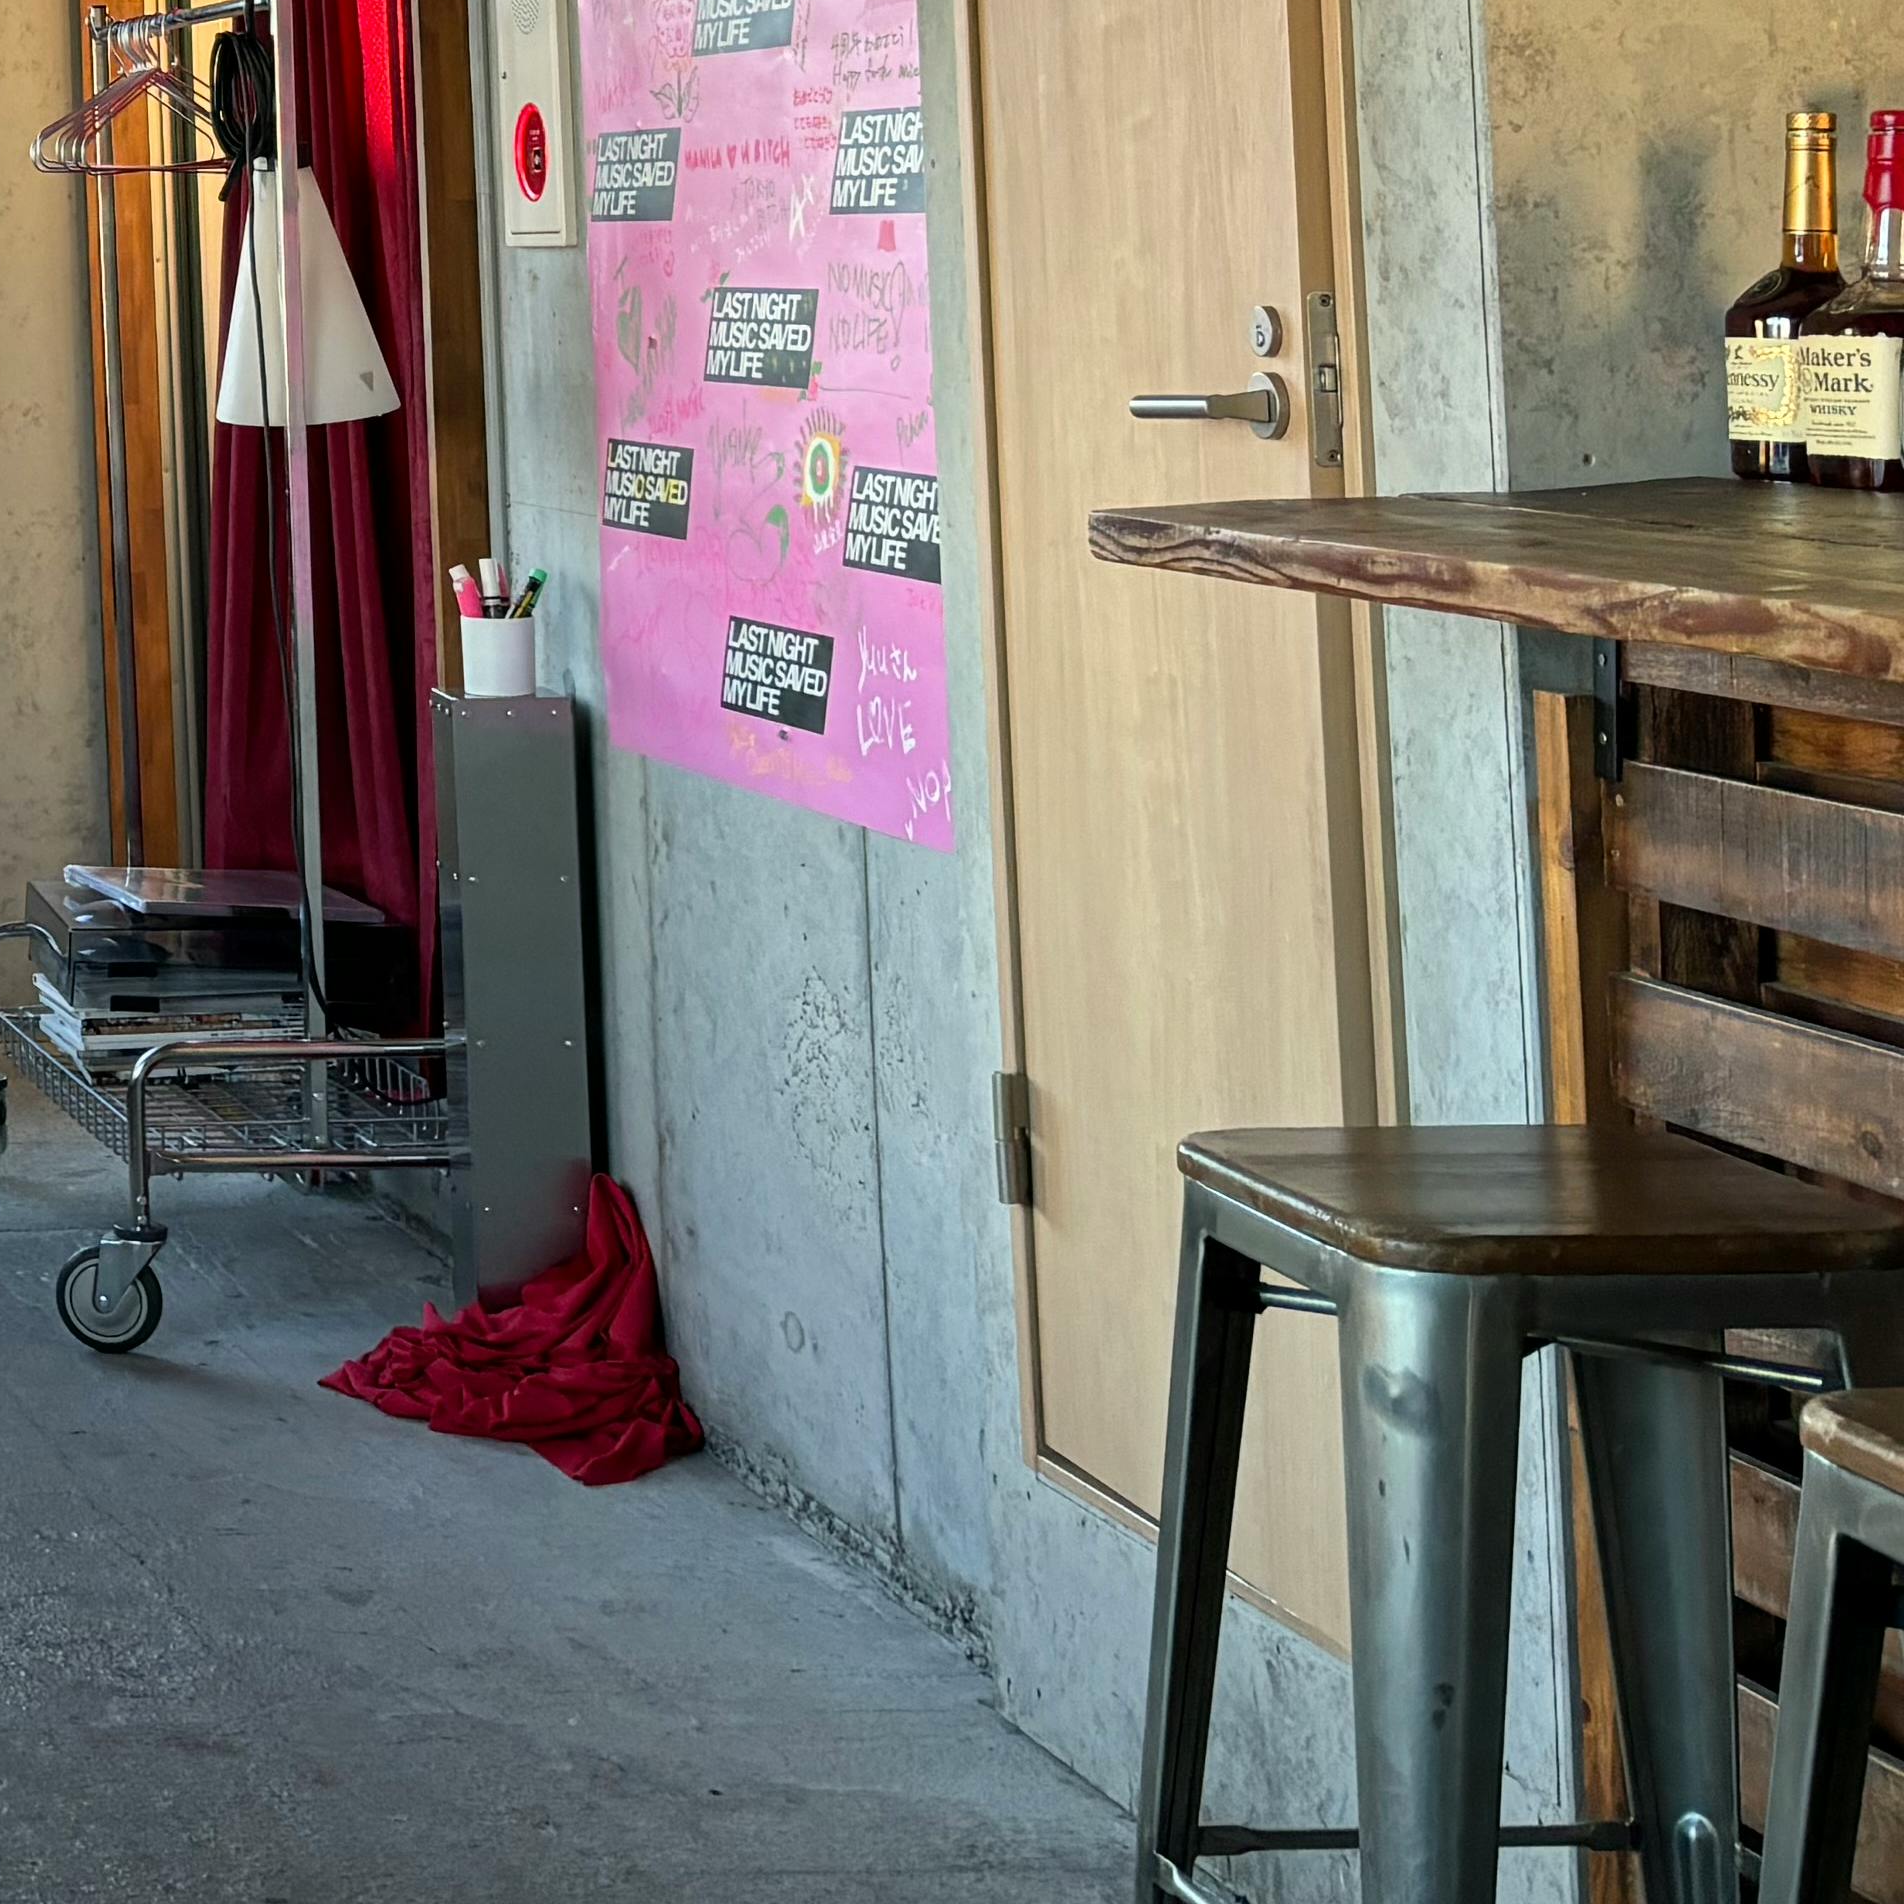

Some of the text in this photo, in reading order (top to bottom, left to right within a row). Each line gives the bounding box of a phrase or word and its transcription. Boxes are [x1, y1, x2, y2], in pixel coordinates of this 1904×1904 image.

[694, 18, 751, 50] MY LIFE
[839, 114, 886, 146] LAST
[598, 133, 667, 162] LAST NIGHT
[835, 146, 891, 177] MUSIC
[595, 160, 675, 189] MUSIC SAVED
[592, 190, 637, 216] MY LIFE
[832, 177, 898, 208] MY LIFE
[713, 292, 802, 321] LAST NIGHT
[709, 321, 811, 352] MUSIC SAVED
[706, 349, 764, 378] MY LIFE
[1799, 346, 1872, 367] Maker's
[1814, 372, 1874, 393] Mark
[1809, 404, 1857, 416] WHISKY
[607, 442, 681, 476] LAST NIGHT
[644, 476, 689, 505] SAVED
[853, 471, 895, 503] LAST
[604, 496, 651, 527] MY LIFE
[849, 502, 901, 537] MUSIC
[845, 532, 872, 563] MY
[870, 537, 908, 570] LIFE
[728, 620, 819, 664] LAST NIGHT
[726, 649, 828, 698] MUSIC SAVED
[723, 677, 782, 716] MY LIFE
